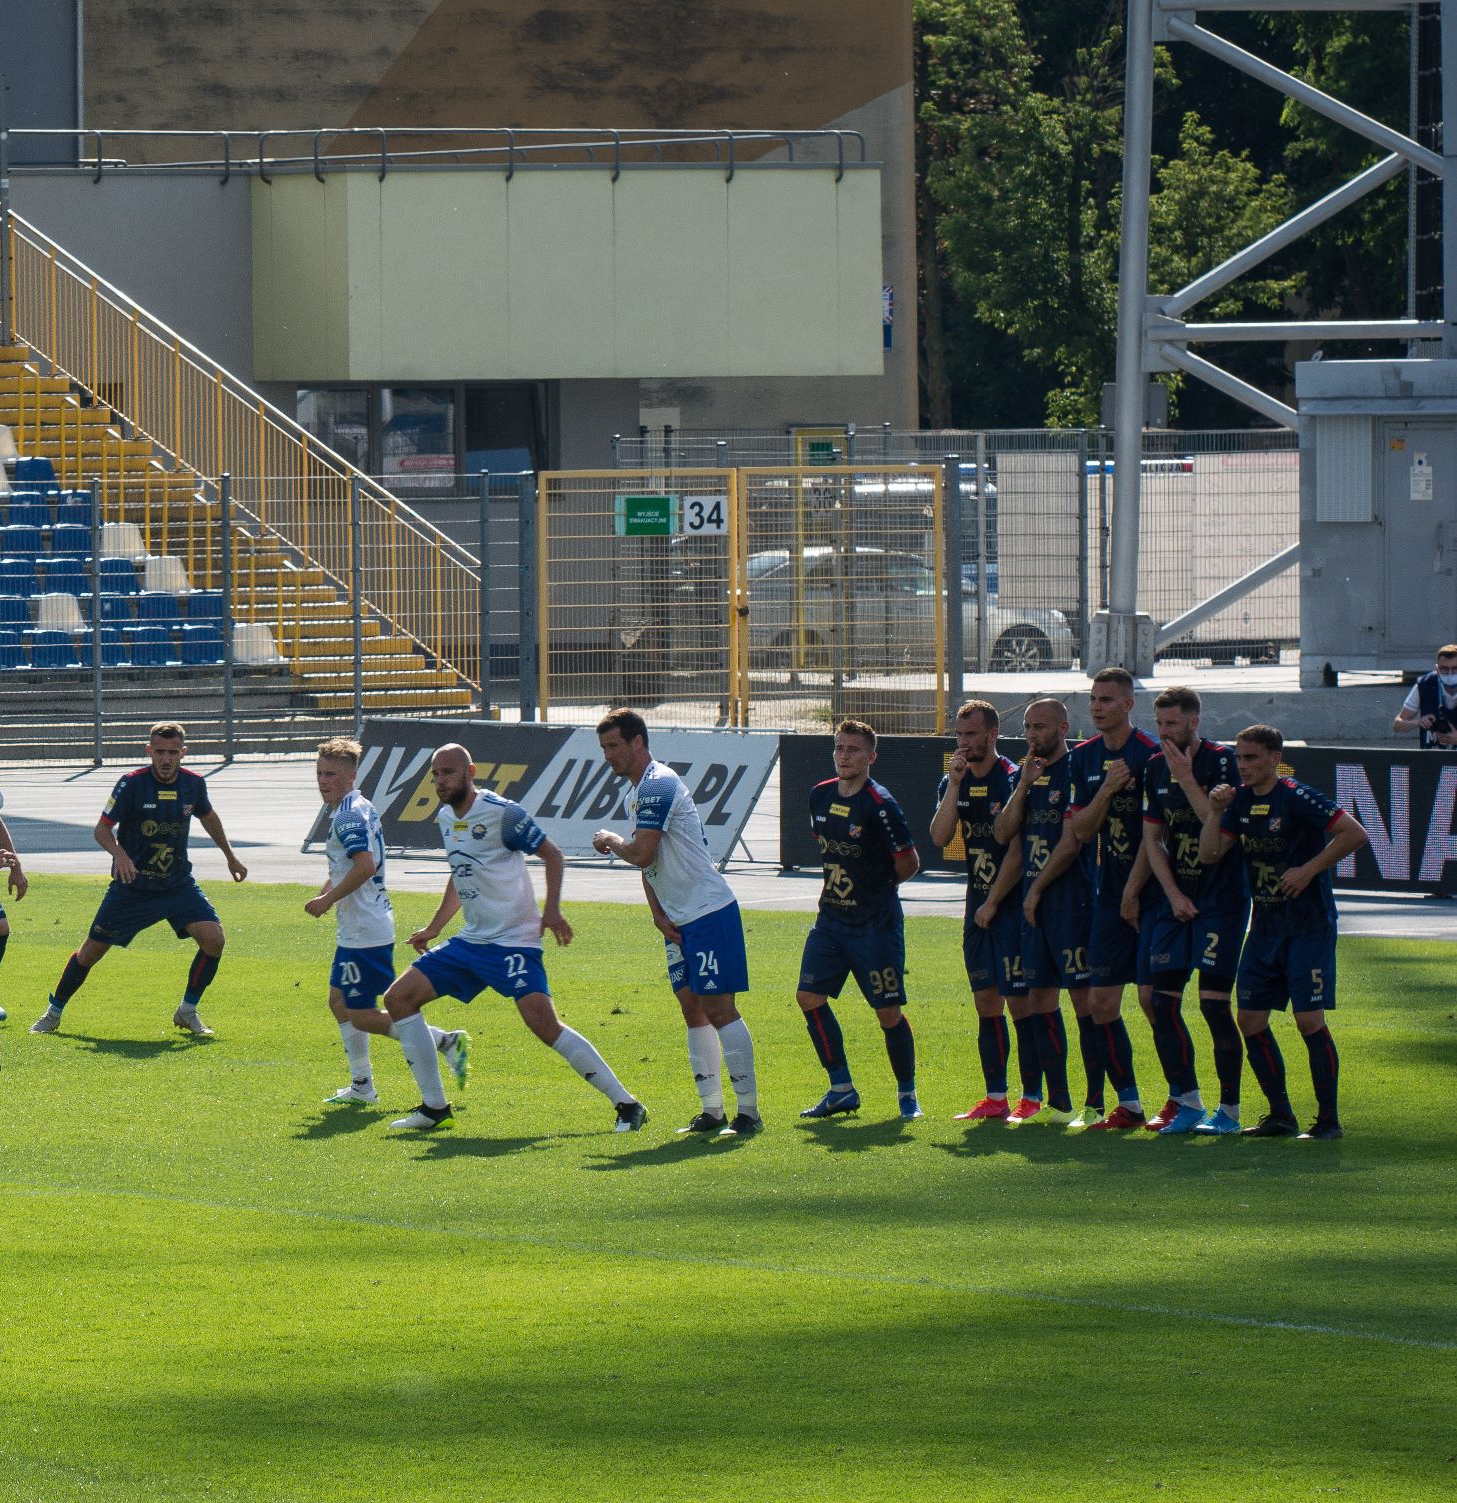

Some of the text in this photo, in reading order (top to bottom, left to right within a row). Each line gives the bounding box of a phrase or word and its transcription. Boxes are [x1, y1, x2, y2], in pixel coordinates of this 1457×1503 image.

[688, 501, 725, 530] 34
[451, 864, 473, 878] GE
[968, 848, 996, 884] 75
[823, 863, 854, 899] 75
[1203, 932, 1219, 959] 2
[339, 962, 362, 985] 20
[504, 953, 529, 978] 22
[696, 950, 719, 976] 24
[1003, 955, 1023, 981] 14
[1062, 947, 1089, 974] 20
[869, 966, 899, 995] 98
[1311, 968, 1323, 995] 5
